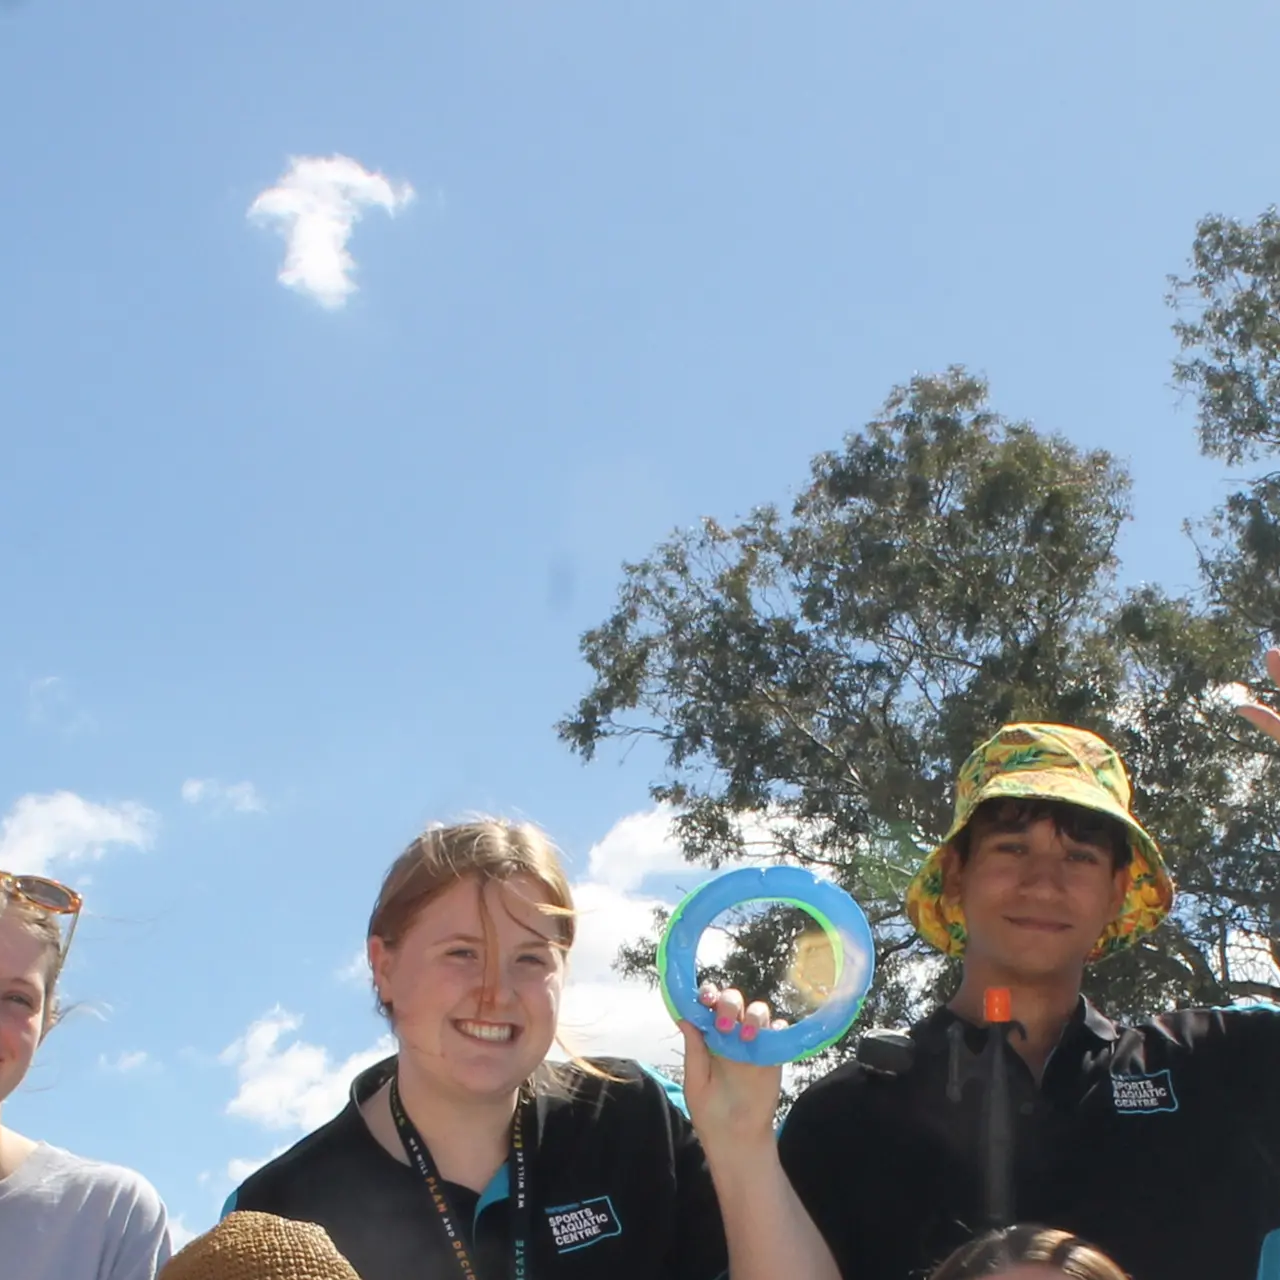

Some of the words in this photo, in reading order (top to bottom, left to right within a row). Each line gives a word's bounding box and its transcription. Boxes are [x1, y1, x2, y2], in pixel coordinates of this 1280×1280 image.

[425, 1176, 448, 1213] PLAN
[442, 1216, 455, 1238] AND
[549, 1208, 593, 1227] SPORTS
[555, 1225, 601, 1246] CENTRE
